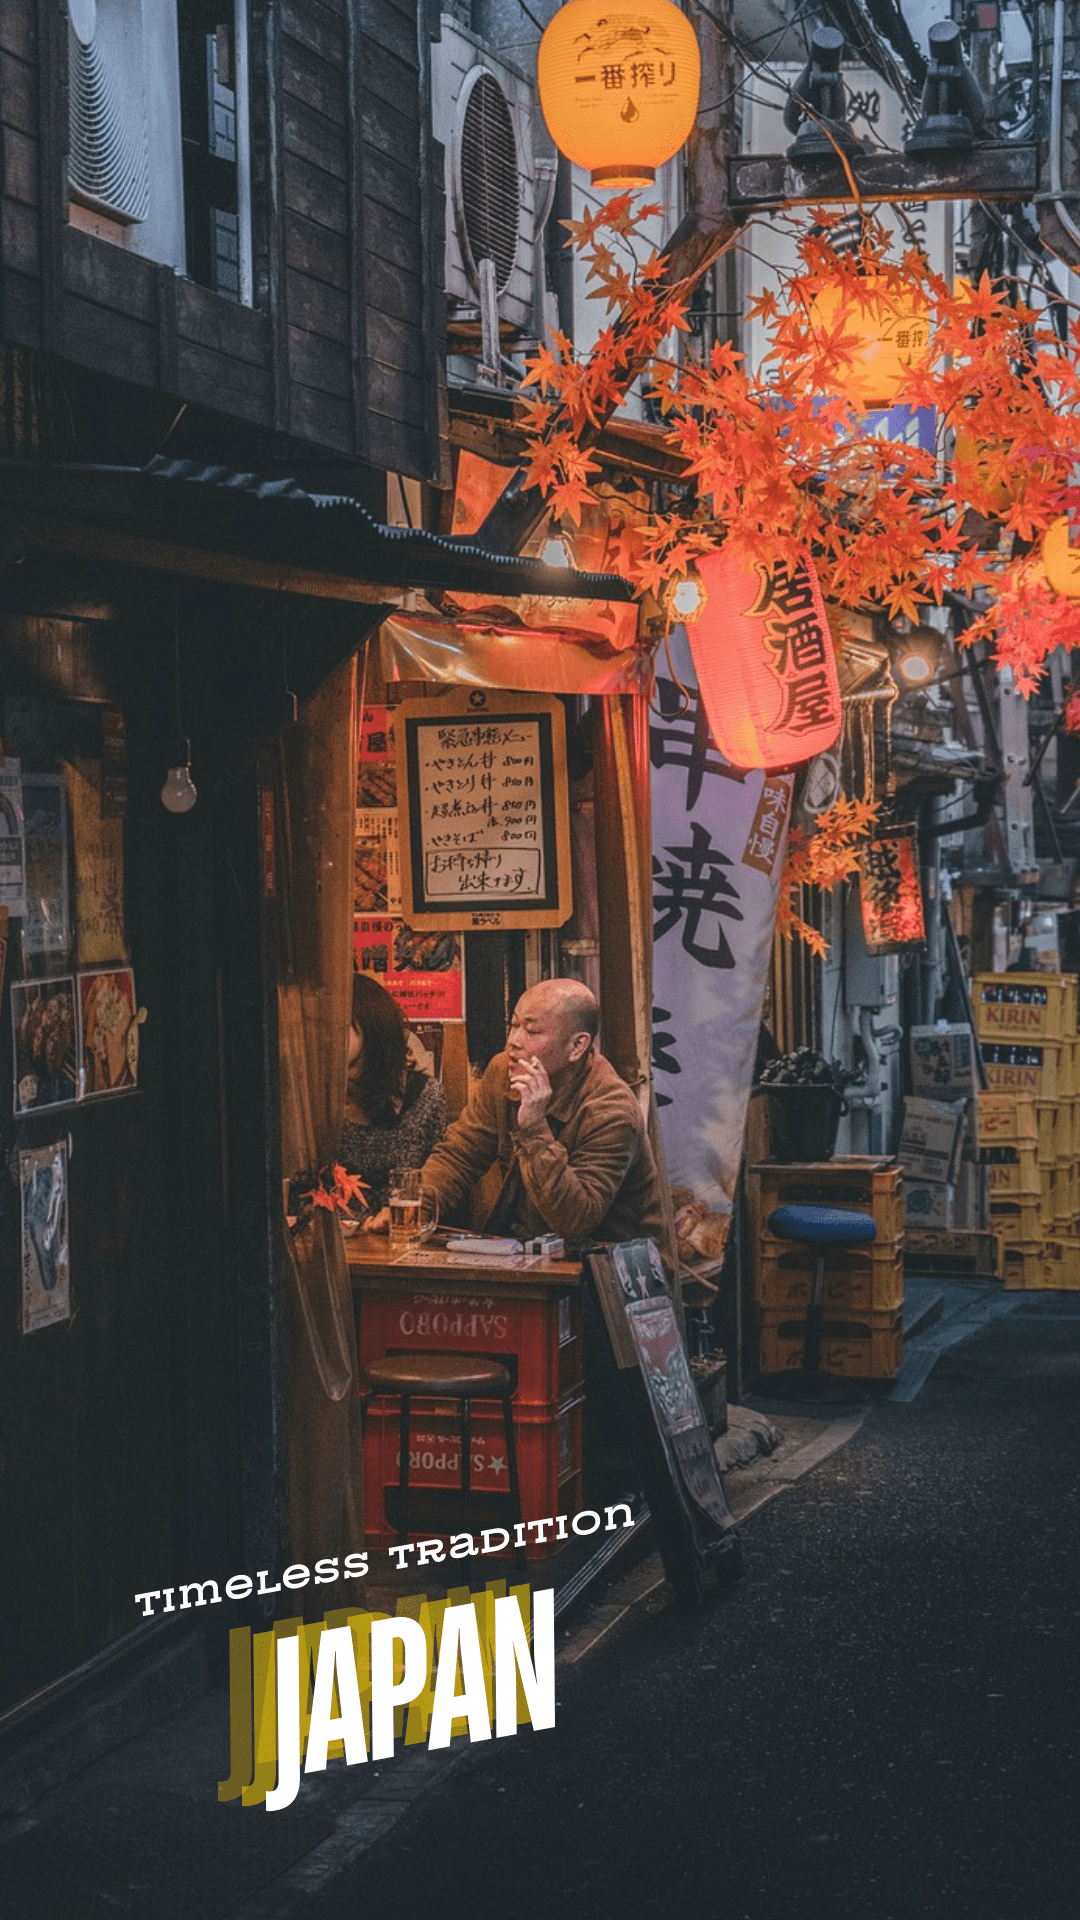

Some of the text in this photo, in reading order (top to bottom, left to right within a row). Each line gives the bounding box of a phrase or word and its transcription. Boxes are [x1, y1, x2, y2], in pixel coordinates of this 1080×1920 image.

[574, 61, 675, 89] 一番搾り
[748, 554, 835, 735] 居酒屋
[748, 787, 786, 865] 味自慢
[986, 1007, 1041, 1025] KIRIN
[398, 1310, 507, 1339] SAPPORO
[396, 1450, 485, 1472] SPPOR
